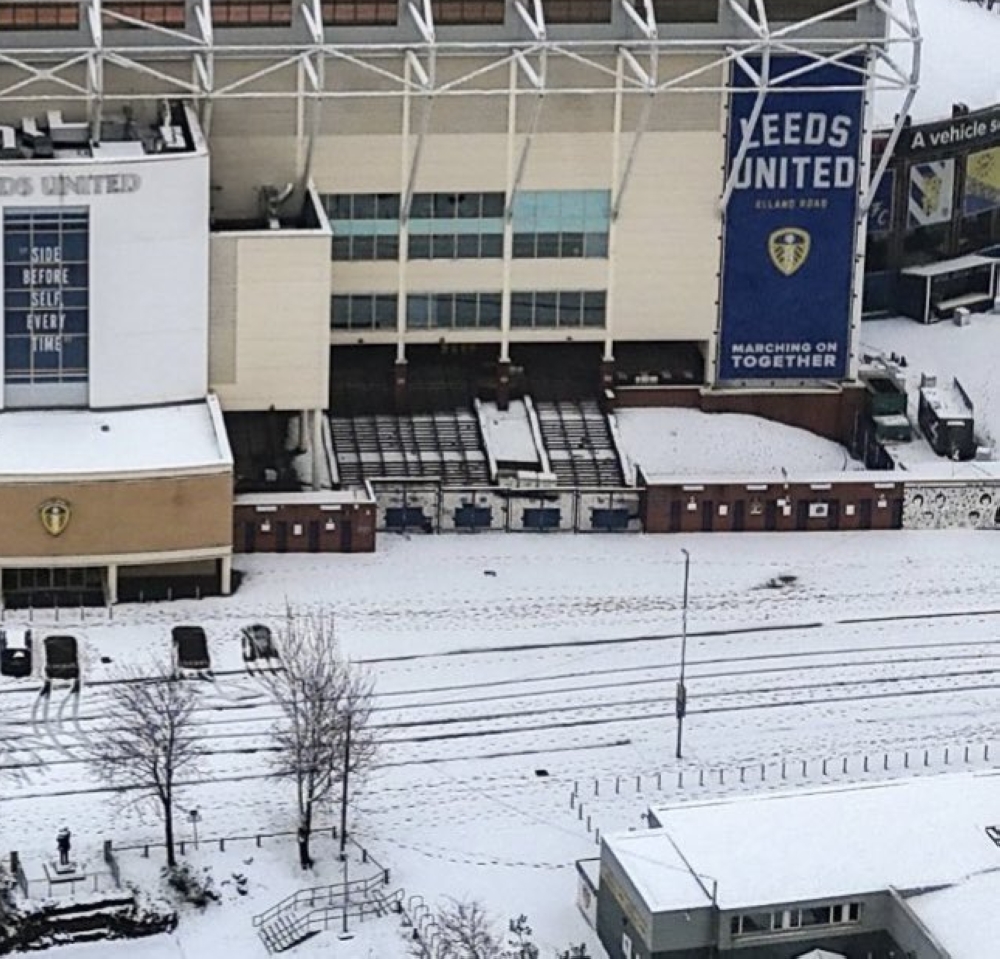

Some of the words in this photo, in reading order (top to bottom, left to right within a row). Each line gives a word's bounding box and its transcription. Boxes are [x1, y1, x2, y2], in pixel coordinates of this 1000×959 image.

[740, 112, 852, 149] LEEDS
[910, 131, 926, 150] A
[929, 120, 987, 146] vehicle
[732, 155, 855, 189] UNITED
[41, 173, 141, 196] UNITED
[22, 268, 69, 284] BEFORE
[26, 314, 67, 330] EVERY
[732, 342, 812, 353] MARCHING
[816, 341, 837, 352] ON
[731, 354, 836, 368] TOGETHER
